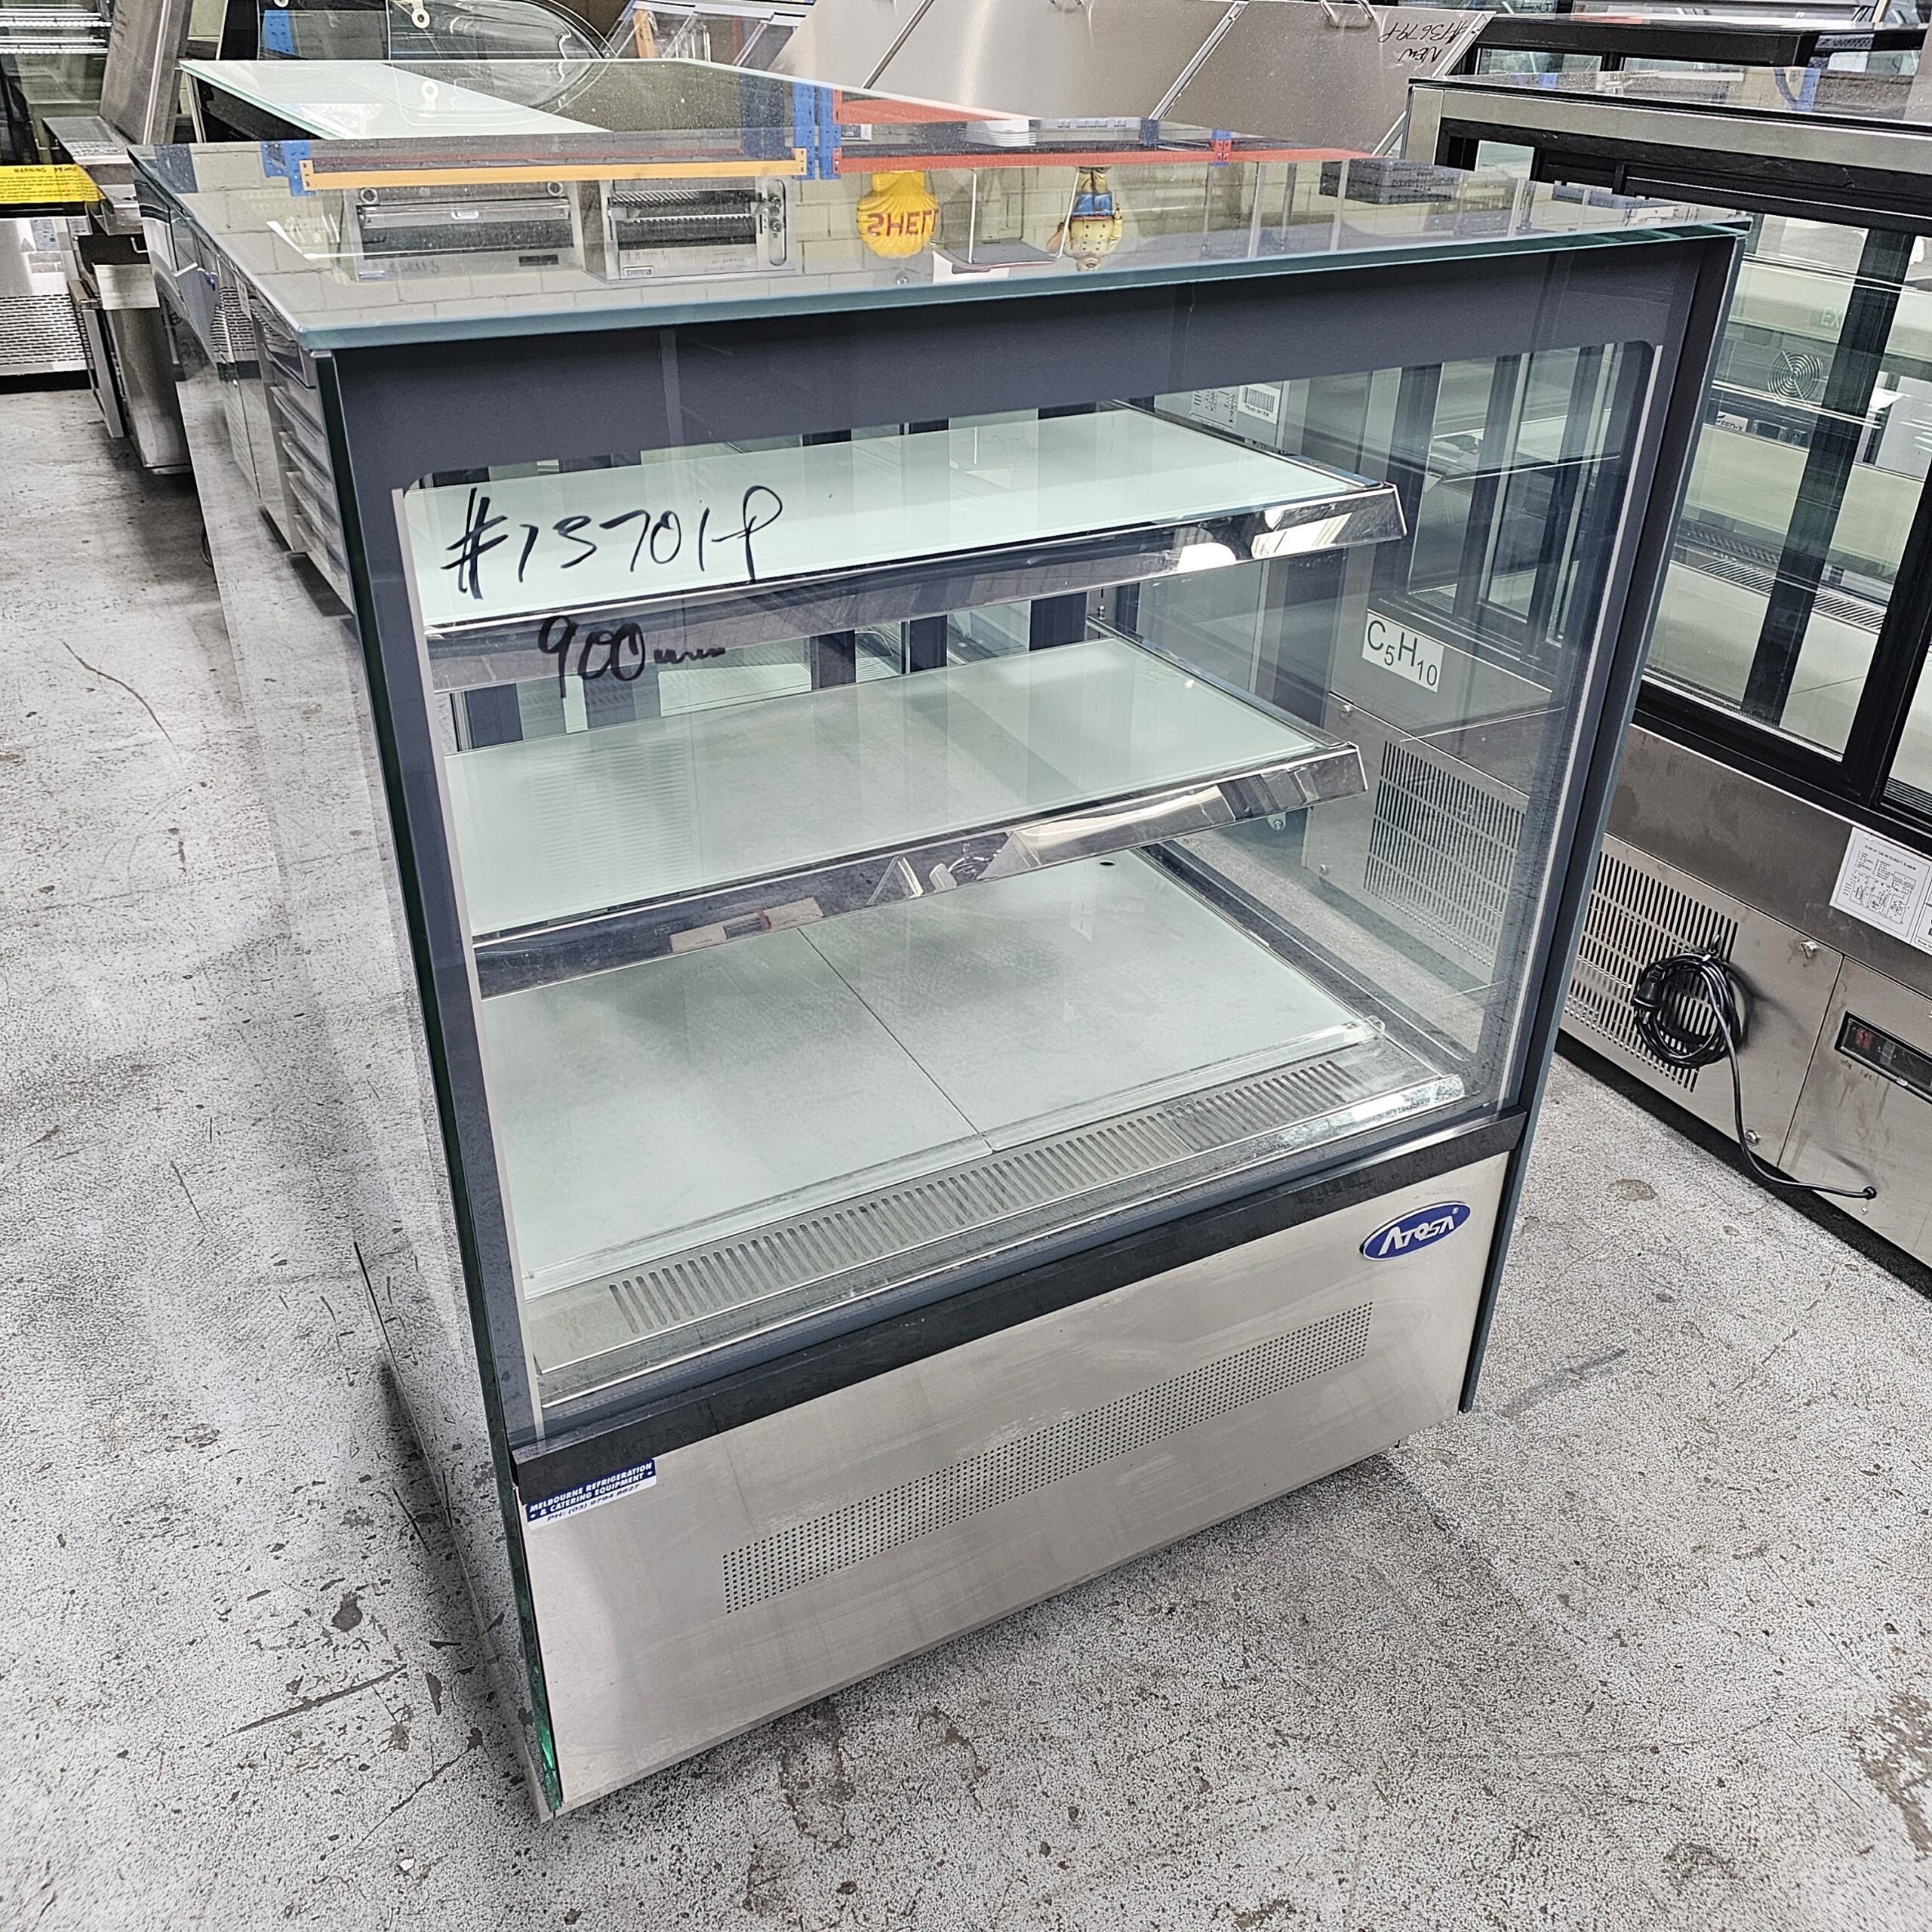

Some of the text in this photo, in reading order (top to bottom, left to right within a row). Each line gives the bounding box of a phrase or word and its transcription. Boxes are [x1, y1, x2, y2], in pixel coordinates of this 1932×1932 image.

[1397, 46, 1443, 63] NEW
[529, 1462, 653, 1513] MELBOURNE REFRIGERATION
[550, 1492, 592, 1512] CATERING
[595, 1472, 645, 1496] EQUIPMENT
[568, 1503, 588, 1515] (03)
